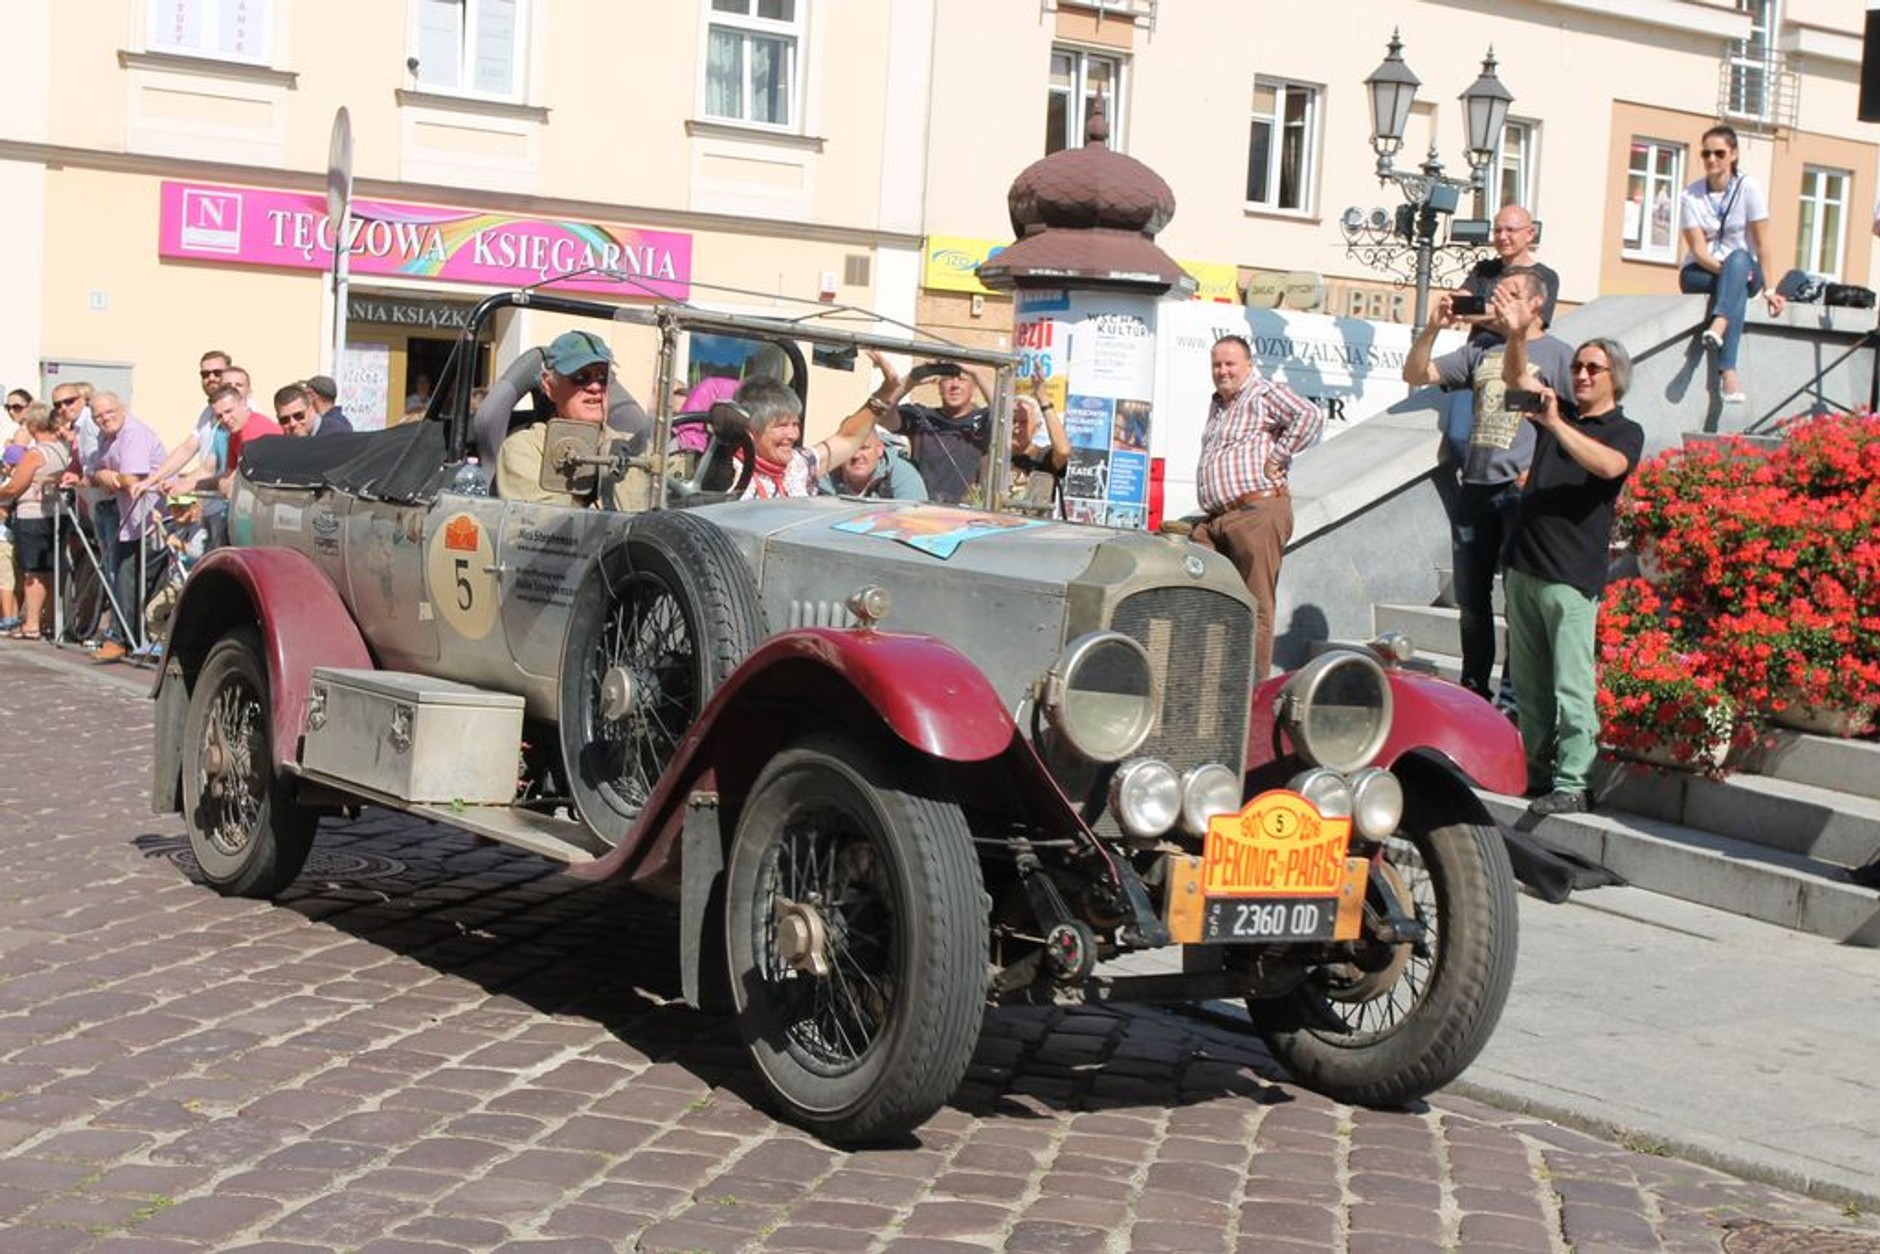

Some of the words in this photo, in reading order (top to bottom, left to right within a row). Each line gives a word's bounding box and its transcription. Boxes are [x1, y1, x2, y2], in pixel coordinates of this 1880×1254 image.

[198, 197, 228, 229] N
[267, 208, 447, 263] TĘCZOWA
[471, 231, 676, 281] KSIĘGARNIA
[392, 306, 466, 330] KSIĄŻK
[455, 558, 473, 611] 5
[1275, 814, 1284, 833] 5
[1208, 831, 1278, 887] PEKING
[1284, 834, 1343, 887] PARIS
[1232, 903, 1287, 936] 2360
